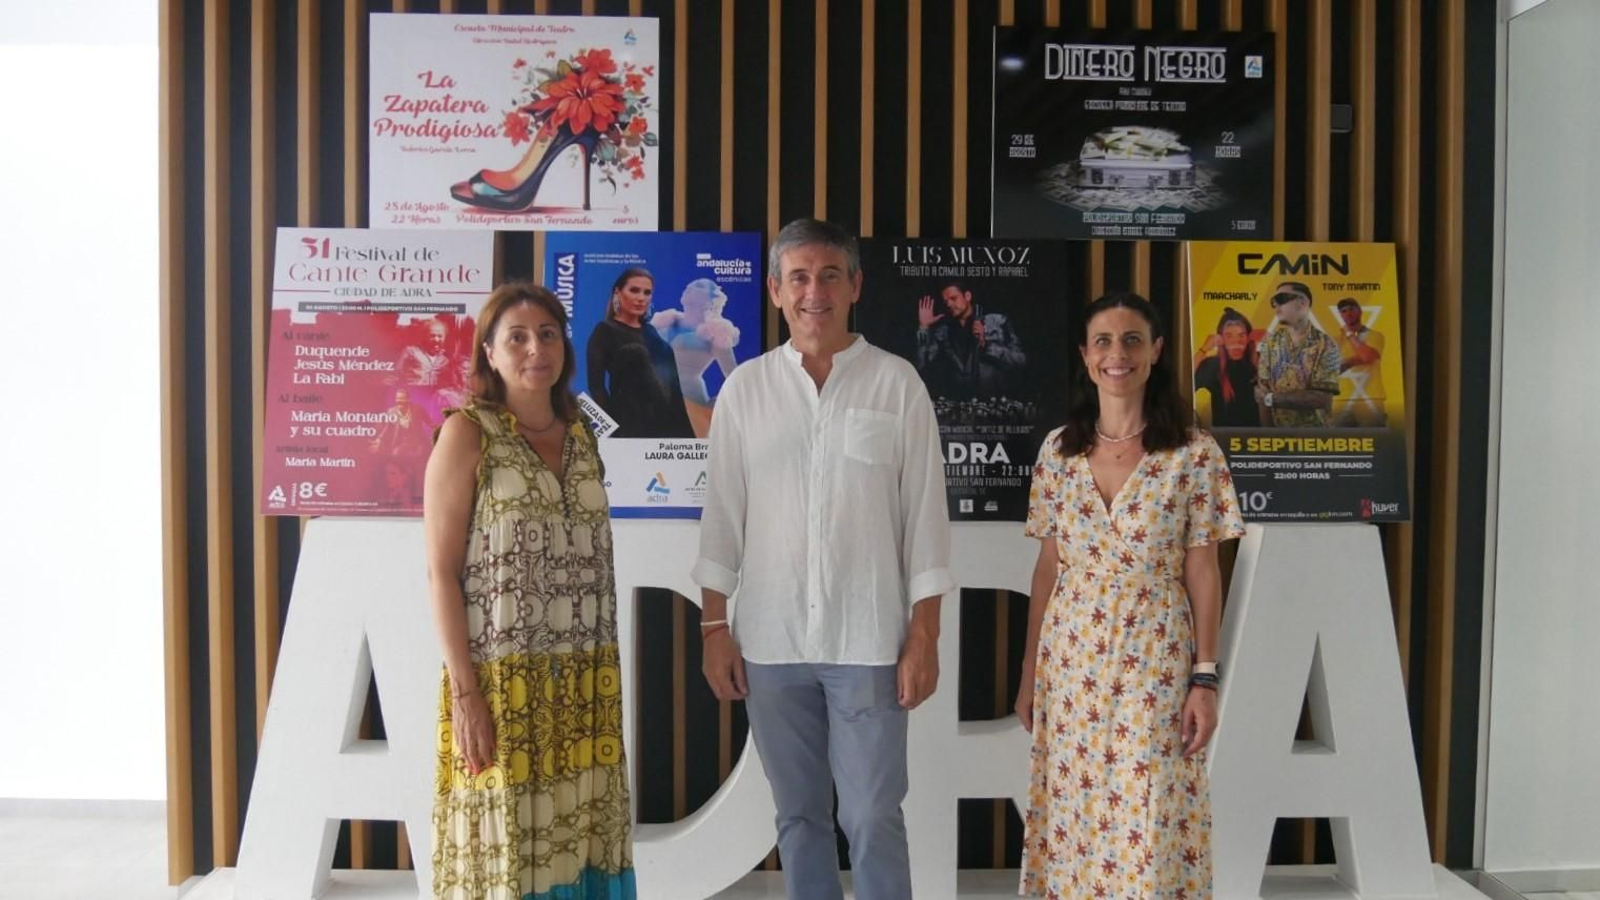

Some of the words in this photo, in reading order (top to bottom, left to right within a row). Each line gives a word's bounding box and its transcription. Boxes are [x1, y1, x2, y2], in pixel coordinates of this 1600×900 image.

[1045, 43, 1135, 81] DINERO
[1144, 46, 1227, 83] NEGRO
[417, 70, 456, 88] La
[384, 94, 489, 118] Zapatera
[373, 117, 500, 144] Prodigiosa
[1012, 134, 1022, 145] 29
[1222, 132, 1234, 144] 22
[1216, 146, 1242, 158] HORAS
[400, 202, 412, 211] de
[524, 214, 543, 224] San
[336, 246, 406, 262] Festival
[414, 247, 440, 262] de
[893, 246, 942, 264] LUIS
[696, 258, 744, 268] andalucía
[289, 263, 368, 283] Cante
[378, 264, 480, 284] Grande
[714, 266, 752, 275] cultura
[900, 266, 930, 276] TRIBUTO
[932, 266, 937, 276] A
[938, 266, 965, 276] CAMILO
[967, 266, 990, 276] SESTO
[992, 266, 996, 276] Y
[998, 266, 1029, 277] RAPHAEL
[334, 288, 378, 297] CIUDAD
[381, 288, 396, 297] DE
[401, 288, 432, 298] ADRA
[1323, 282, 1345, 292] TONY
[294, 345, 370, 358] Duquende
[294, 358, 334, 372] Jesús
[294, 372, 311, 385] La
[290, 427, 298, 438] y
[303, 426, 320, 436] su
[326, 425, 376, 437] cuadro
[659, 443, 693, 451] Paloma
[1230, 437, 1242, 452] 5
[1246, 438, 1375, 452] SEPTIEMBRE
[645, 452, 674, 460] LAURA
[944, 465, 986, 476] TIEMBRE
[1274, 472, 1298, 480] 22:00
[1300, 472, 1330, 480] HORAS
